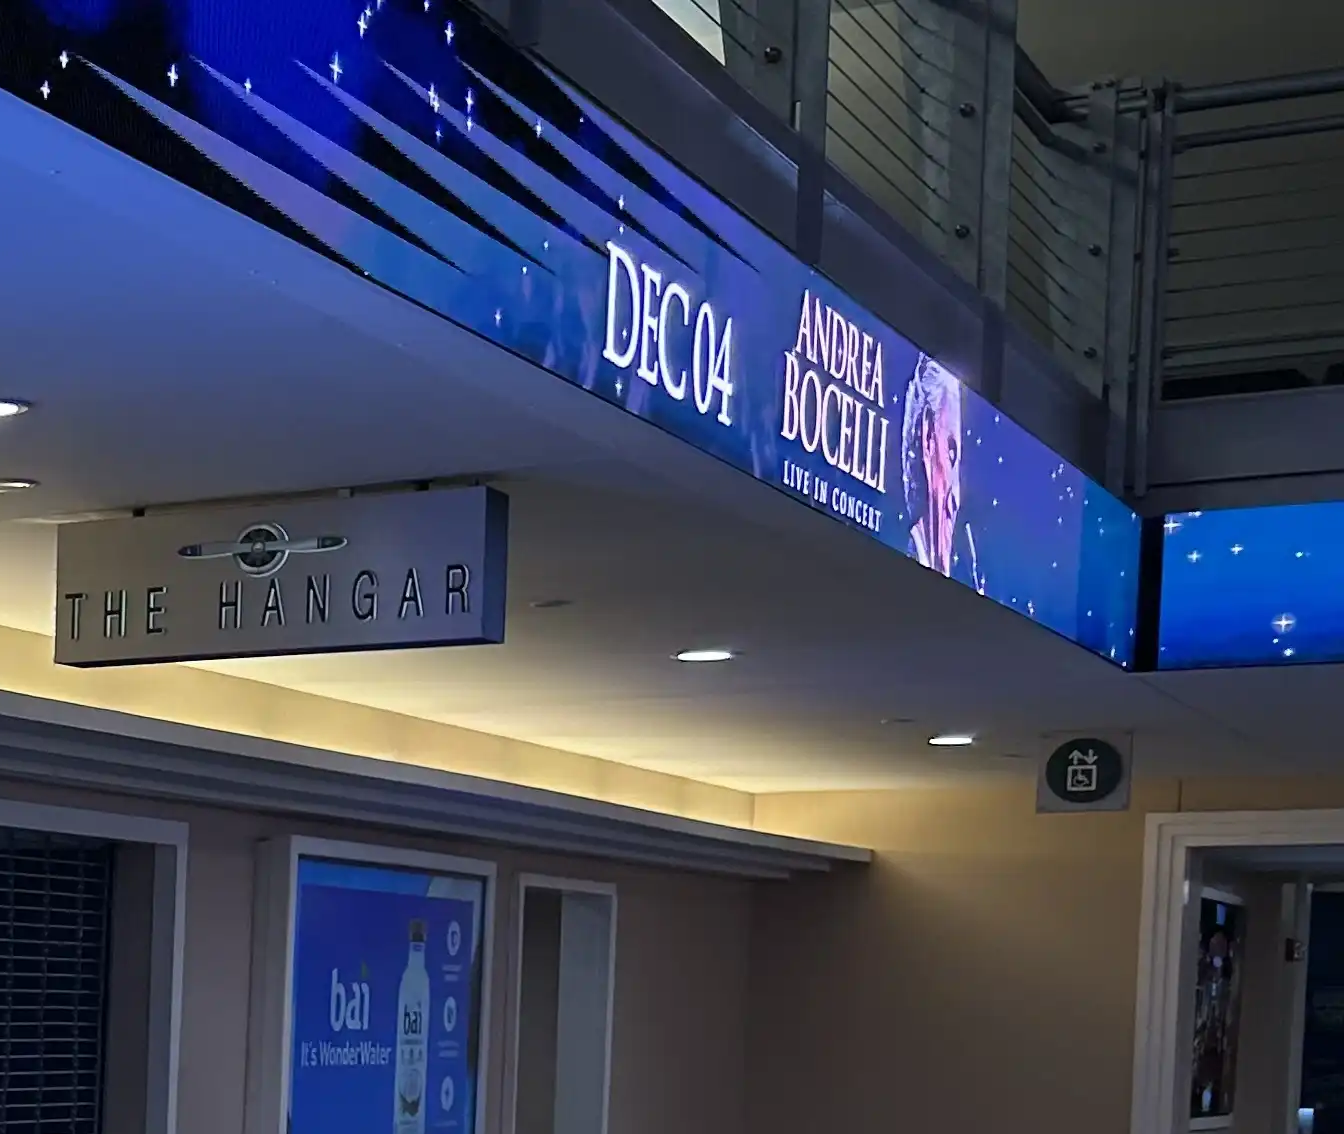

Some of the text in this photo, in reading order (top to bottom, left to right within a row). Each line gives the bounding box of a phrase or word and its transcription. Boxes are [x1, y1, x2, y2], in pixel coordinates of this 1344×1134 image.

[602, 240, 735, 427] DEC 04
[796, 288, 885, 409] ANDREA
[780, 349, 890, 494] BOCELLI
[783, 460, 882, 533] LIVE IN CONCERT
[65, 563, 472, 641] THE HANGAR
[329, 962, 371, 1032] bai
[403, 1002, 422, 1035] bai
[319, 1040, 392, 1067] WonderWater
